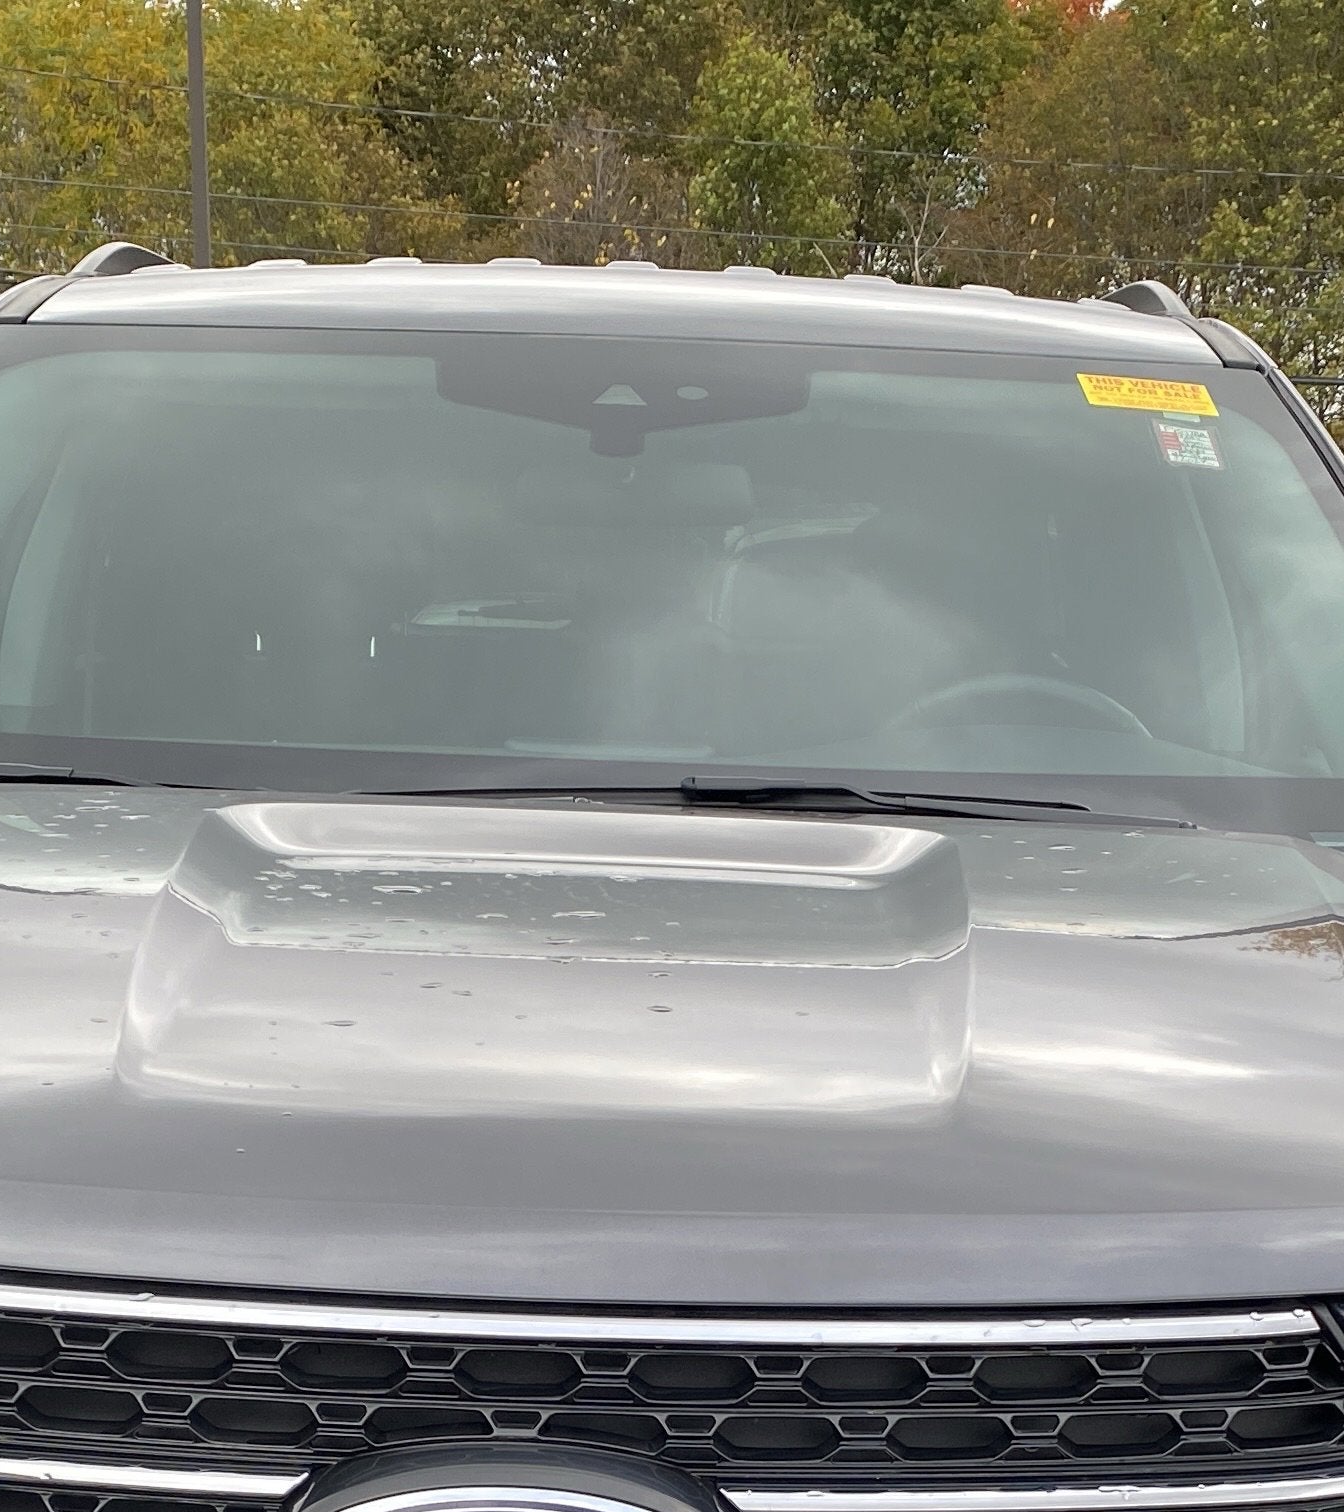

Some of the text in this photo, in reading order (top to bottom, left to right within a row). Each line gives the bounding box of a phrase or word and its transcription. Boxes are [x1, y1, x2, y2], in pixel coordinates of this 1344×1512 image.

[1084, 376, 1201, 392] THIS VEHICLE
[1093, 384, 1201, 399] NOT FOR SALE
